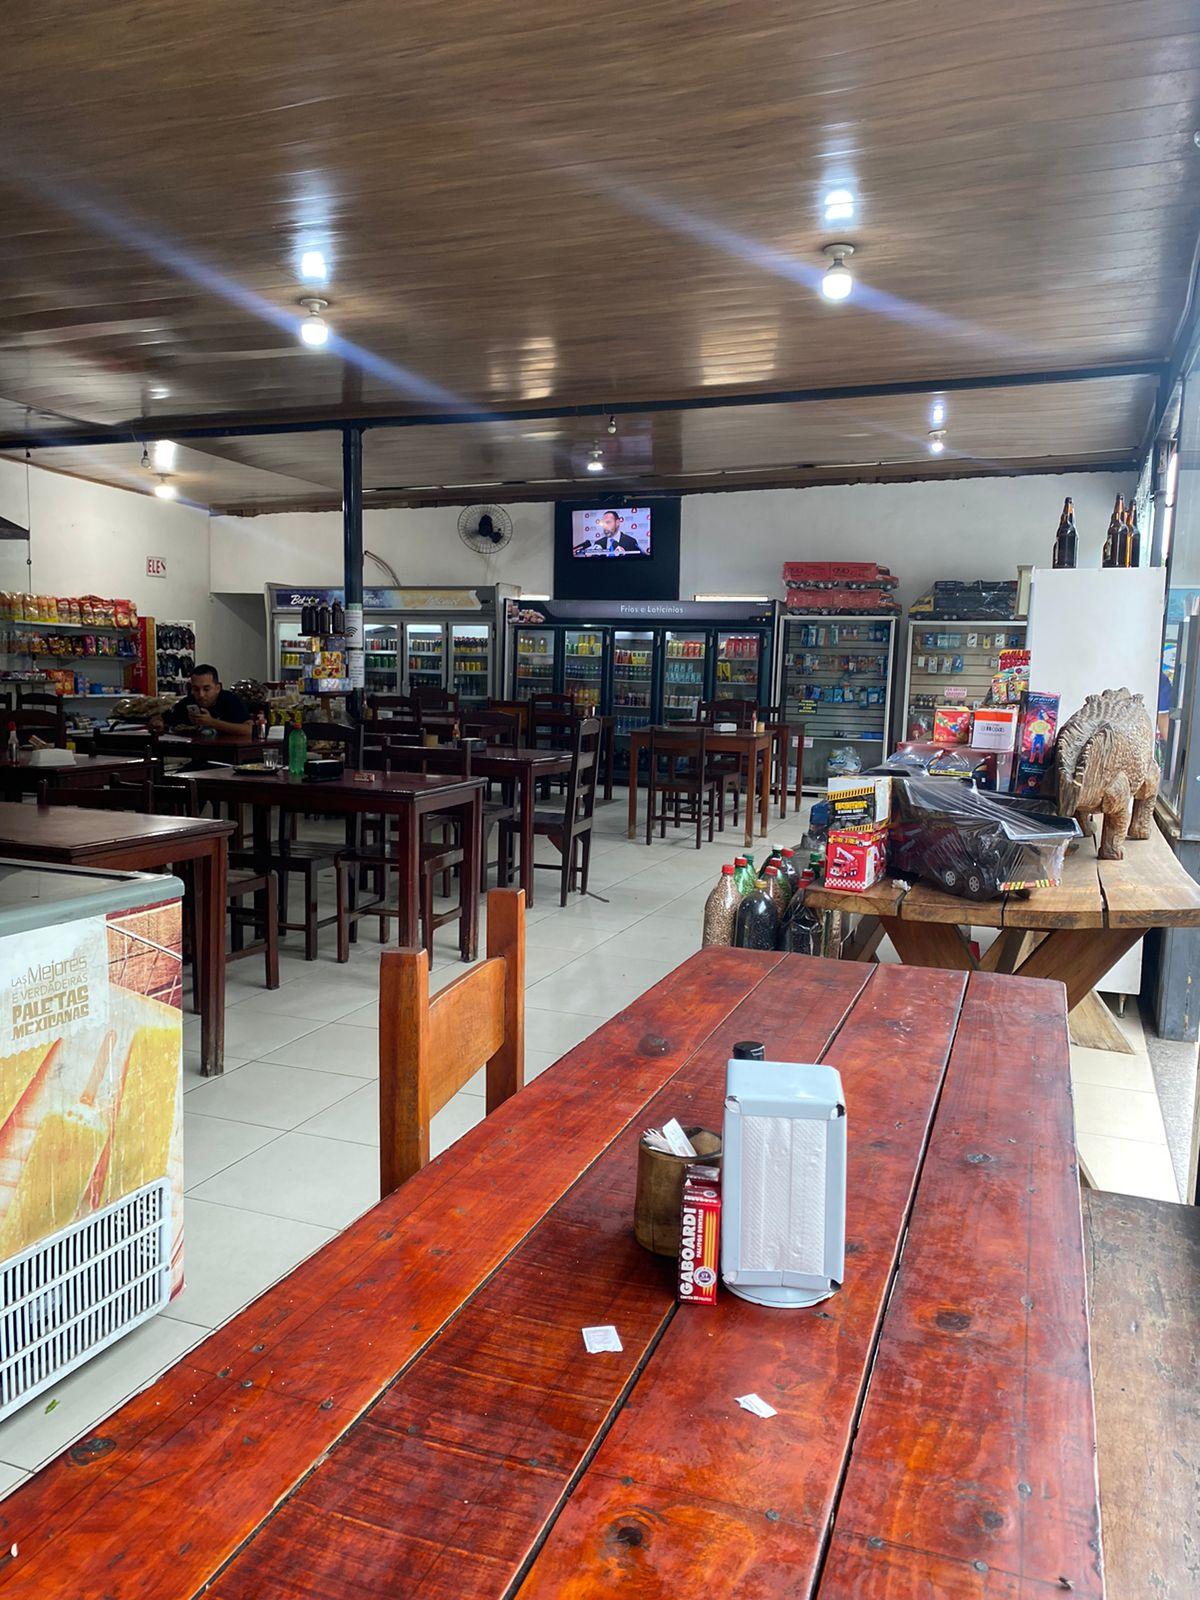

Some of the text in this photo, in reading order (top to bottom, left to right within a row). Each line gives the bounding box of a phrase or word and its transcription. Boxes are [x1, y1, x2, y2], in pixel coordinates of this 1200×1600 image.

[620, 604, 638, 613] Frios
[11, 955, 88, 988] LAS Mejores
[20, 972, 88, 1001] VERDADEIRAS
[12, 984, 89, 1025] PALETAS
[12, 1003, 89, 1041] MEXICANAS
[680, 1207, 697, 1295] GABOARDI
